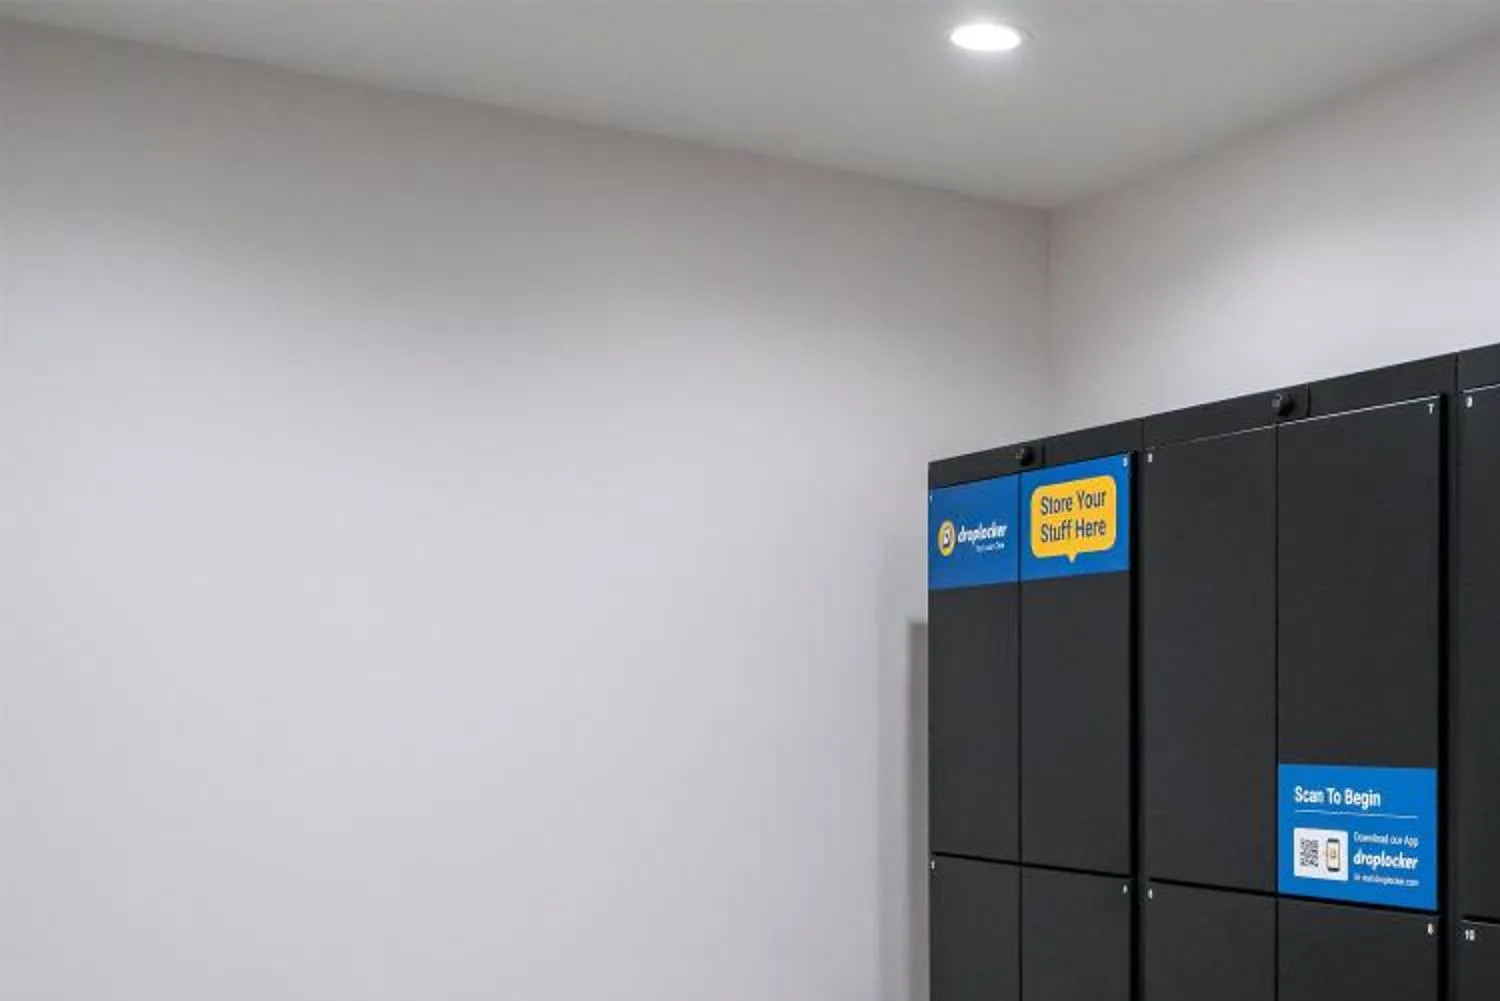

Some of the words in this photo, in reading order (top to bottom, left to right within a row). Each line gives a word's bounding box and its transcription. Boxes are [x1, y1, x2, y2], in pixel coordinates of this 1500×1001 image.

[1040, 495, 1073, 515] Store
[1075, 488, 1107, 511] Your
[957, 521, 1007, 545] droplocker
[1040, 518, 1072, 543] Stuff
[1075, 517, 1106, 540] Here
[1294, 785, 1324, 803] Scan
[1326, 787, 1342, 805] To
[1344, 787, 1382, 810] Begin
[1353, 848, 1418, 869] droplocker
